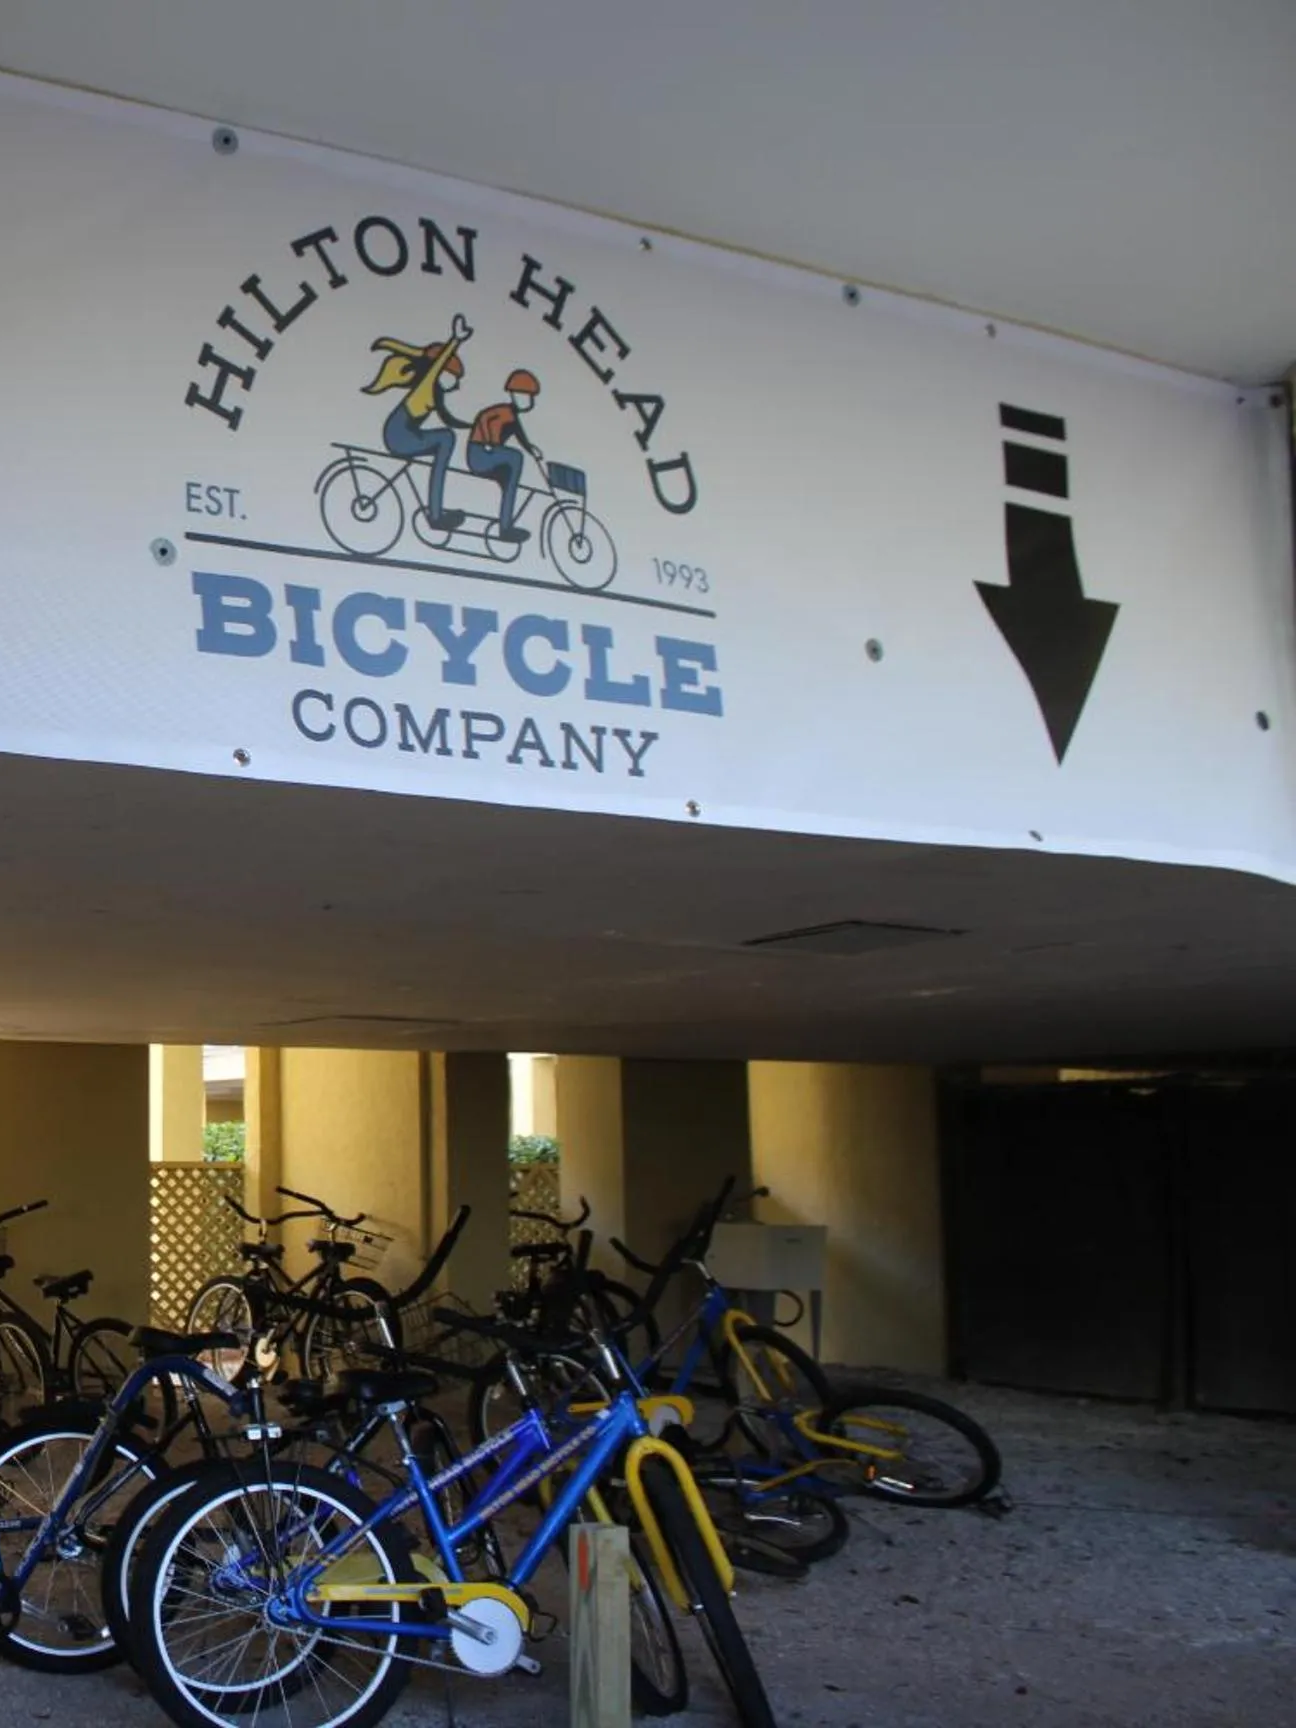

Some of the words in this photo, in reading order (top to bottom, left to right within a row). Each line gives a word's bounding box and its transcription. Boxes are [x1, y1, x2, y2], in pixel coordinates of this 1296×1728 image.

[184, 215, 479, 431] HILTON
[509, 253, 698, 515] HEAD
[185, 481, 248, 520] EST.
[652, 557, 711, 594] 1993
[190, 570, 724, 718] BICYCLE
[290, 688, 659, 778] COMPANY
